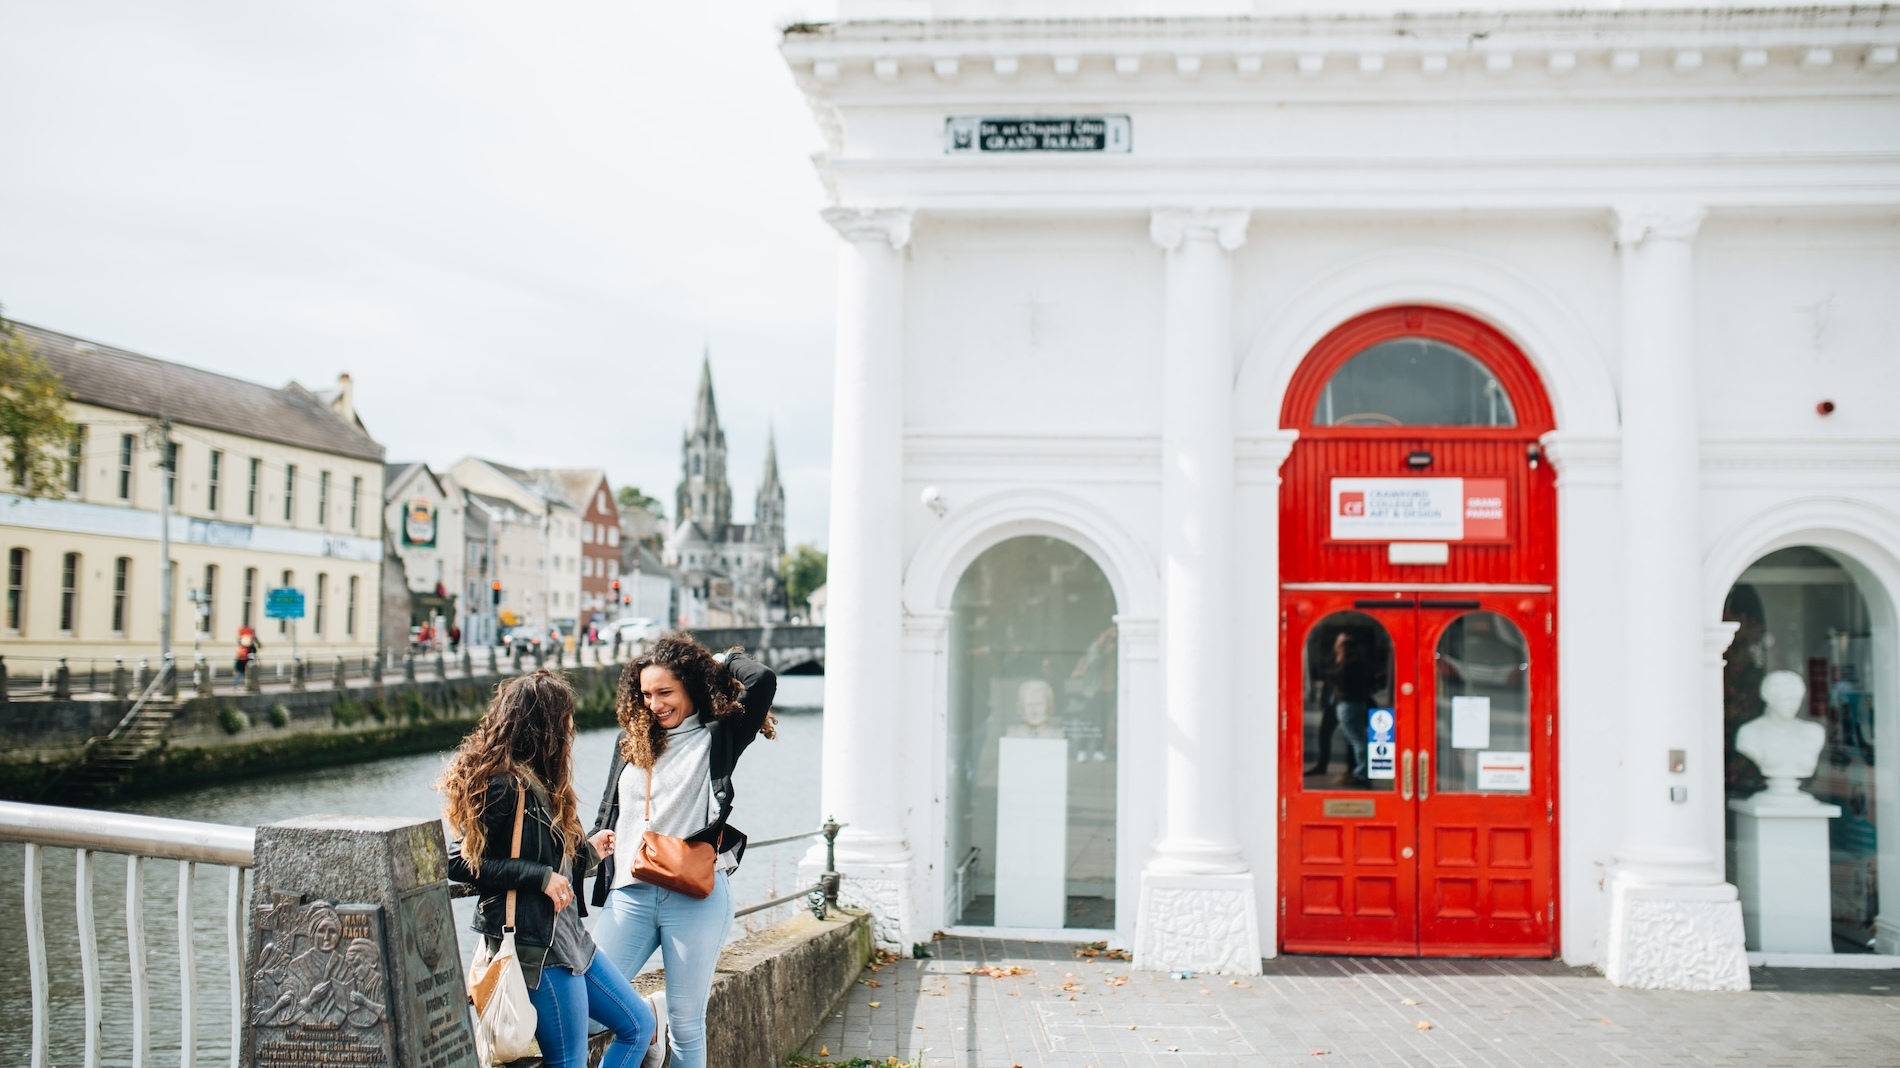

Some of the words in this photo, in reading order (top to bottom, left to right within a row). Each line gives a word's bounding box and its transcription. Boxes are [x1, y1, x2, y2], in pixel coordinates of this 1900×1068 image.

[985, 135, 1037, 149] GRAND
[1042, 135, 1097, 149] PARADE
[1467, 497, 1502, 507] GRAND
[1370, 510, 1389, 518] ART
[1403, 510, 1442, 518] DESIGN
[1465, 508, 1503, 519] PARADE
[344, 914, 367, 926] NANO
[342, 926, 369, 939] NAGLE
[336, 1051, 353, 1062] April
